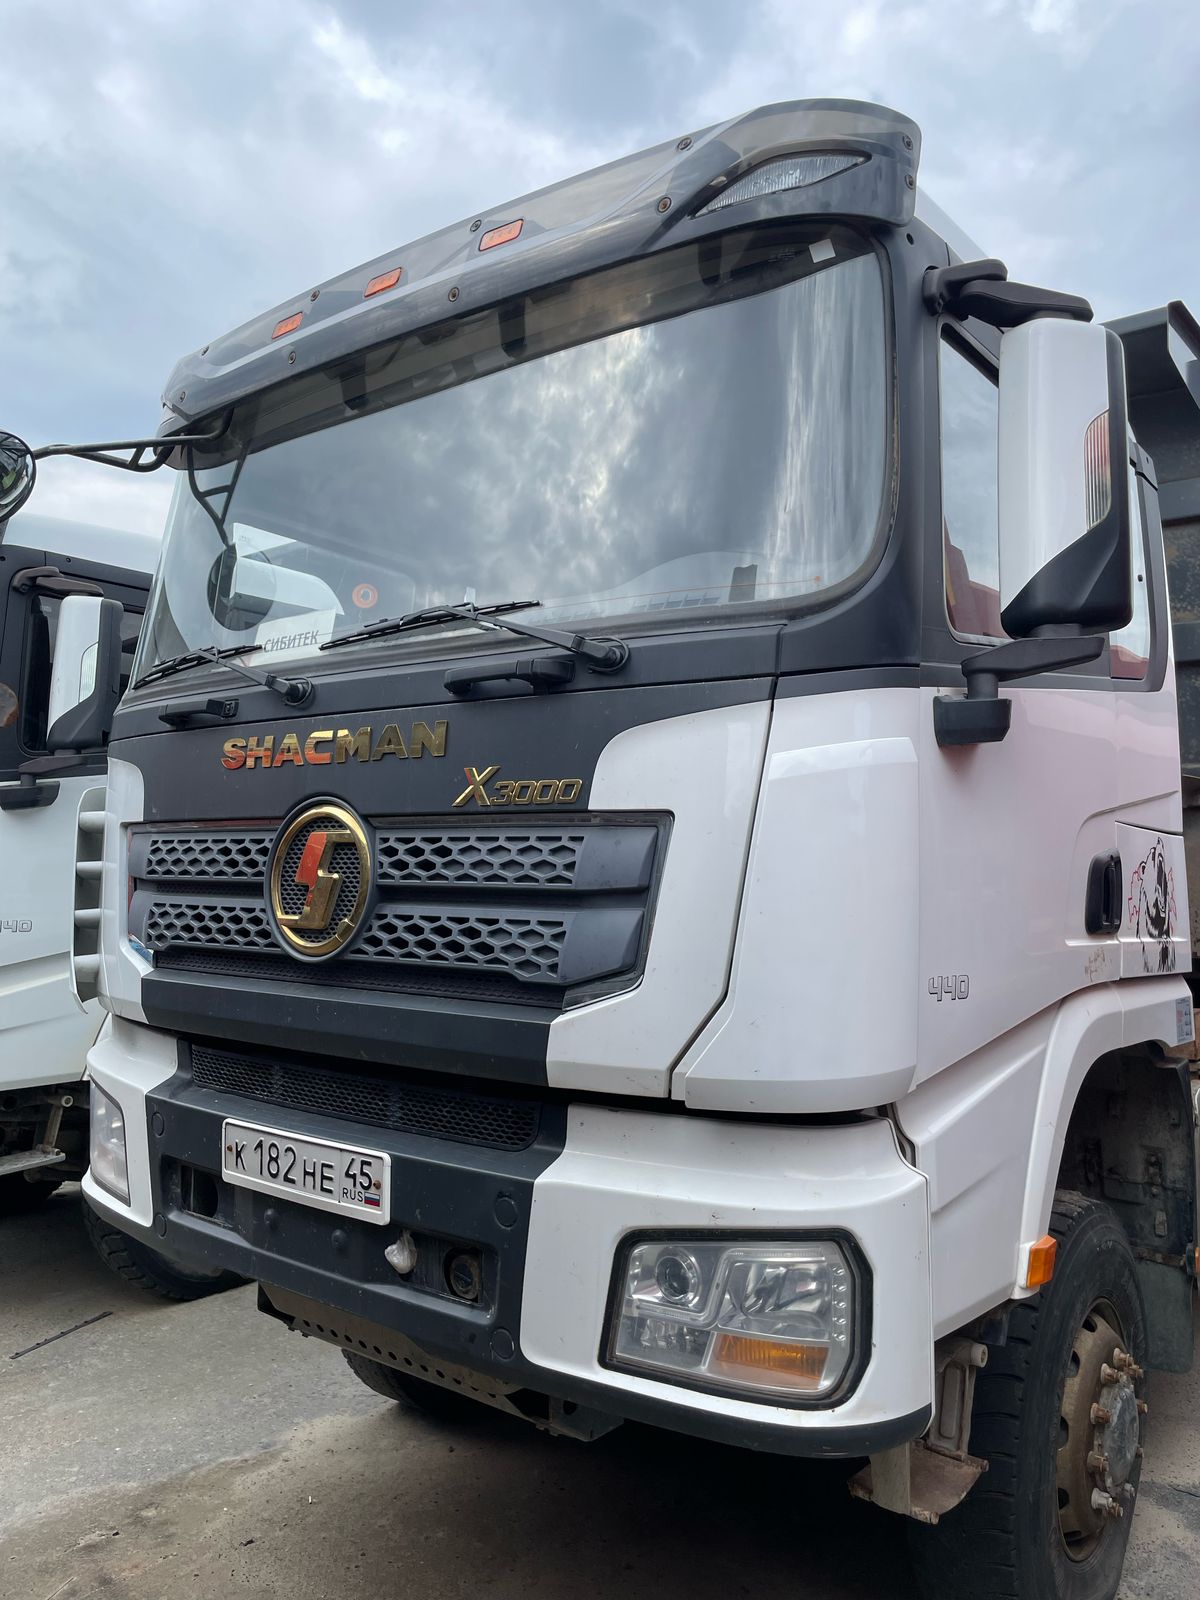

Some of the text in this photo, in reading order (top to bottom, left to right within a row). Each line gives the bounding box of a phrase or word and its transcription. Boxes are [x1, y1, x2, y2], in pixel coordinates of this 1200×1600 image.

[264, 630, 319, 653] СИБИТЕК
[220, 720, 448, 770] SHACMAN
[451, 765, 583, 807] X3000
[0, 919, 33, 933] 40
[928, 974, 970, 1002] 440
[342, 1187, 364, 1202] RUS
